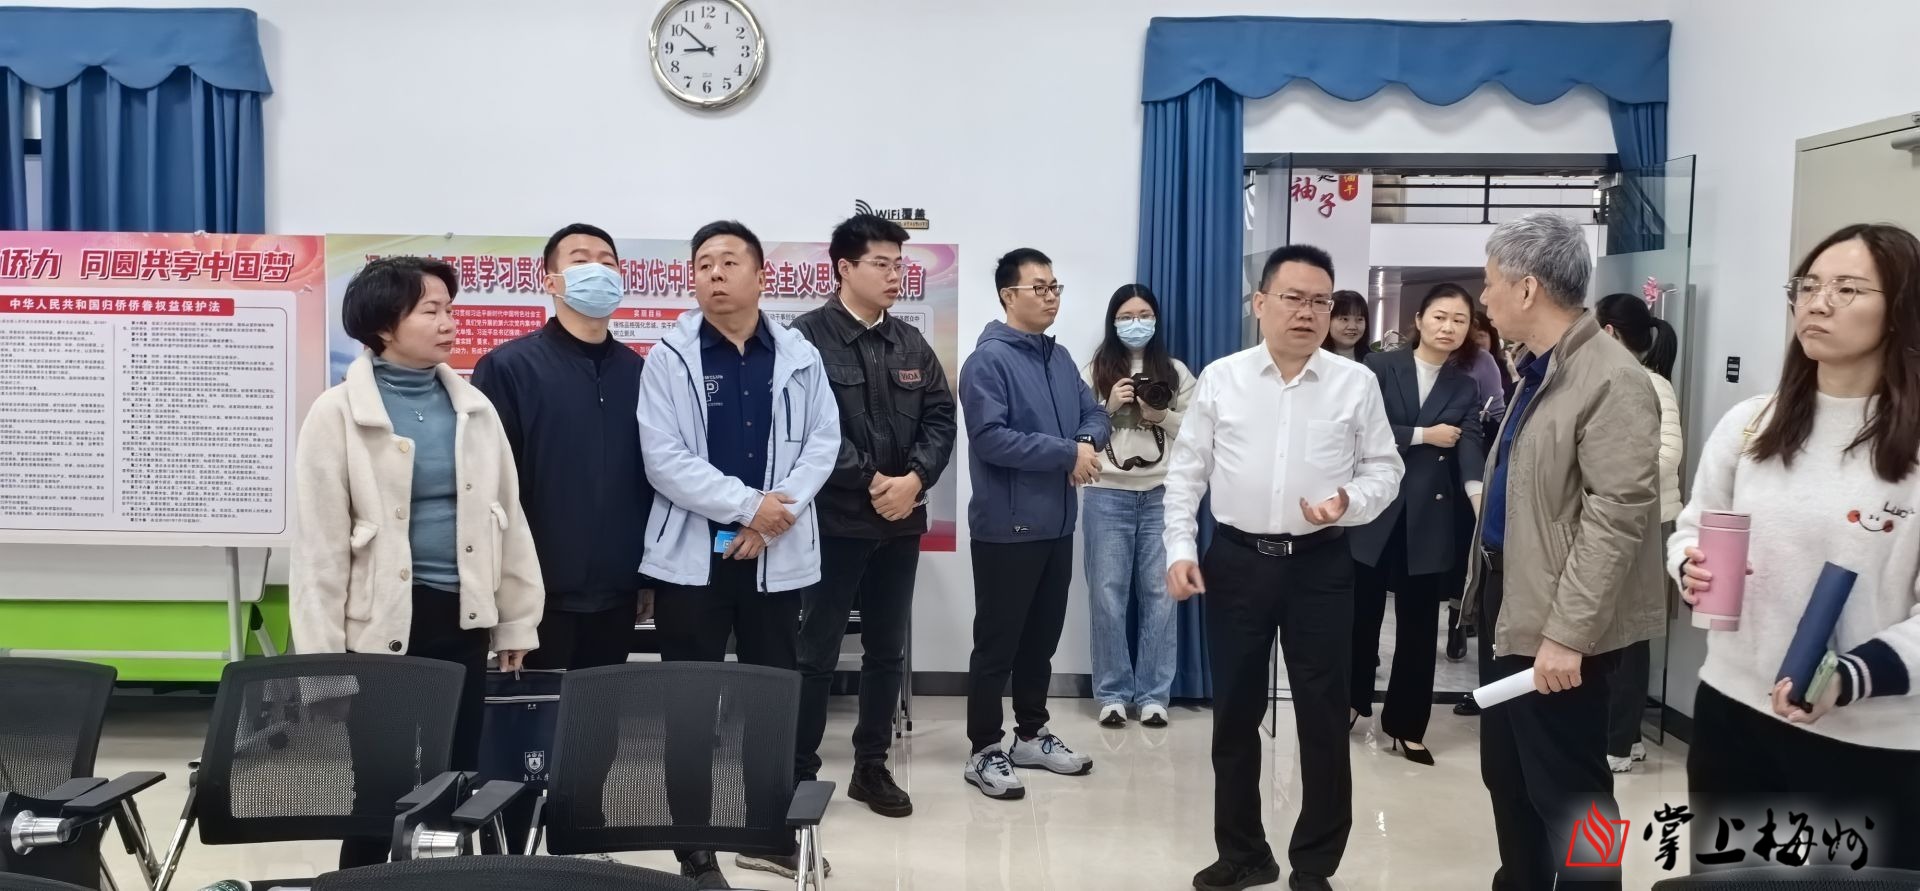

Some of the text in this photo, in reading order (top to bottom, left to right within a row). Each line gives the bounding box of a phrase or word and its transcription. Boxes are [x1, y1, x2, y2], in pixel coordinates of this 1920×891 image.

[685, 10, 695, 23] 11
[701, 6, 716, 19] 12
[725, 12, 729, 24] 1
[671, 24, 684, 37] 10
[736, 27, 745, 40] 2
[665, 42, 674, 55] 9
[741, 45, 750, 58] 3
[671, 61, 680, 73] 8
[734, 63, 743, 77] 4
[683, 75, 693, 88] 7
[702, 80, 712, 94] 6
[722, 77, 732, 90] 5
[0, 248, 294, 282] 侨力 同圆共享中国梦
[9, 298, 220, 313] 中华人民共和国归侨侨眷权益保护法
